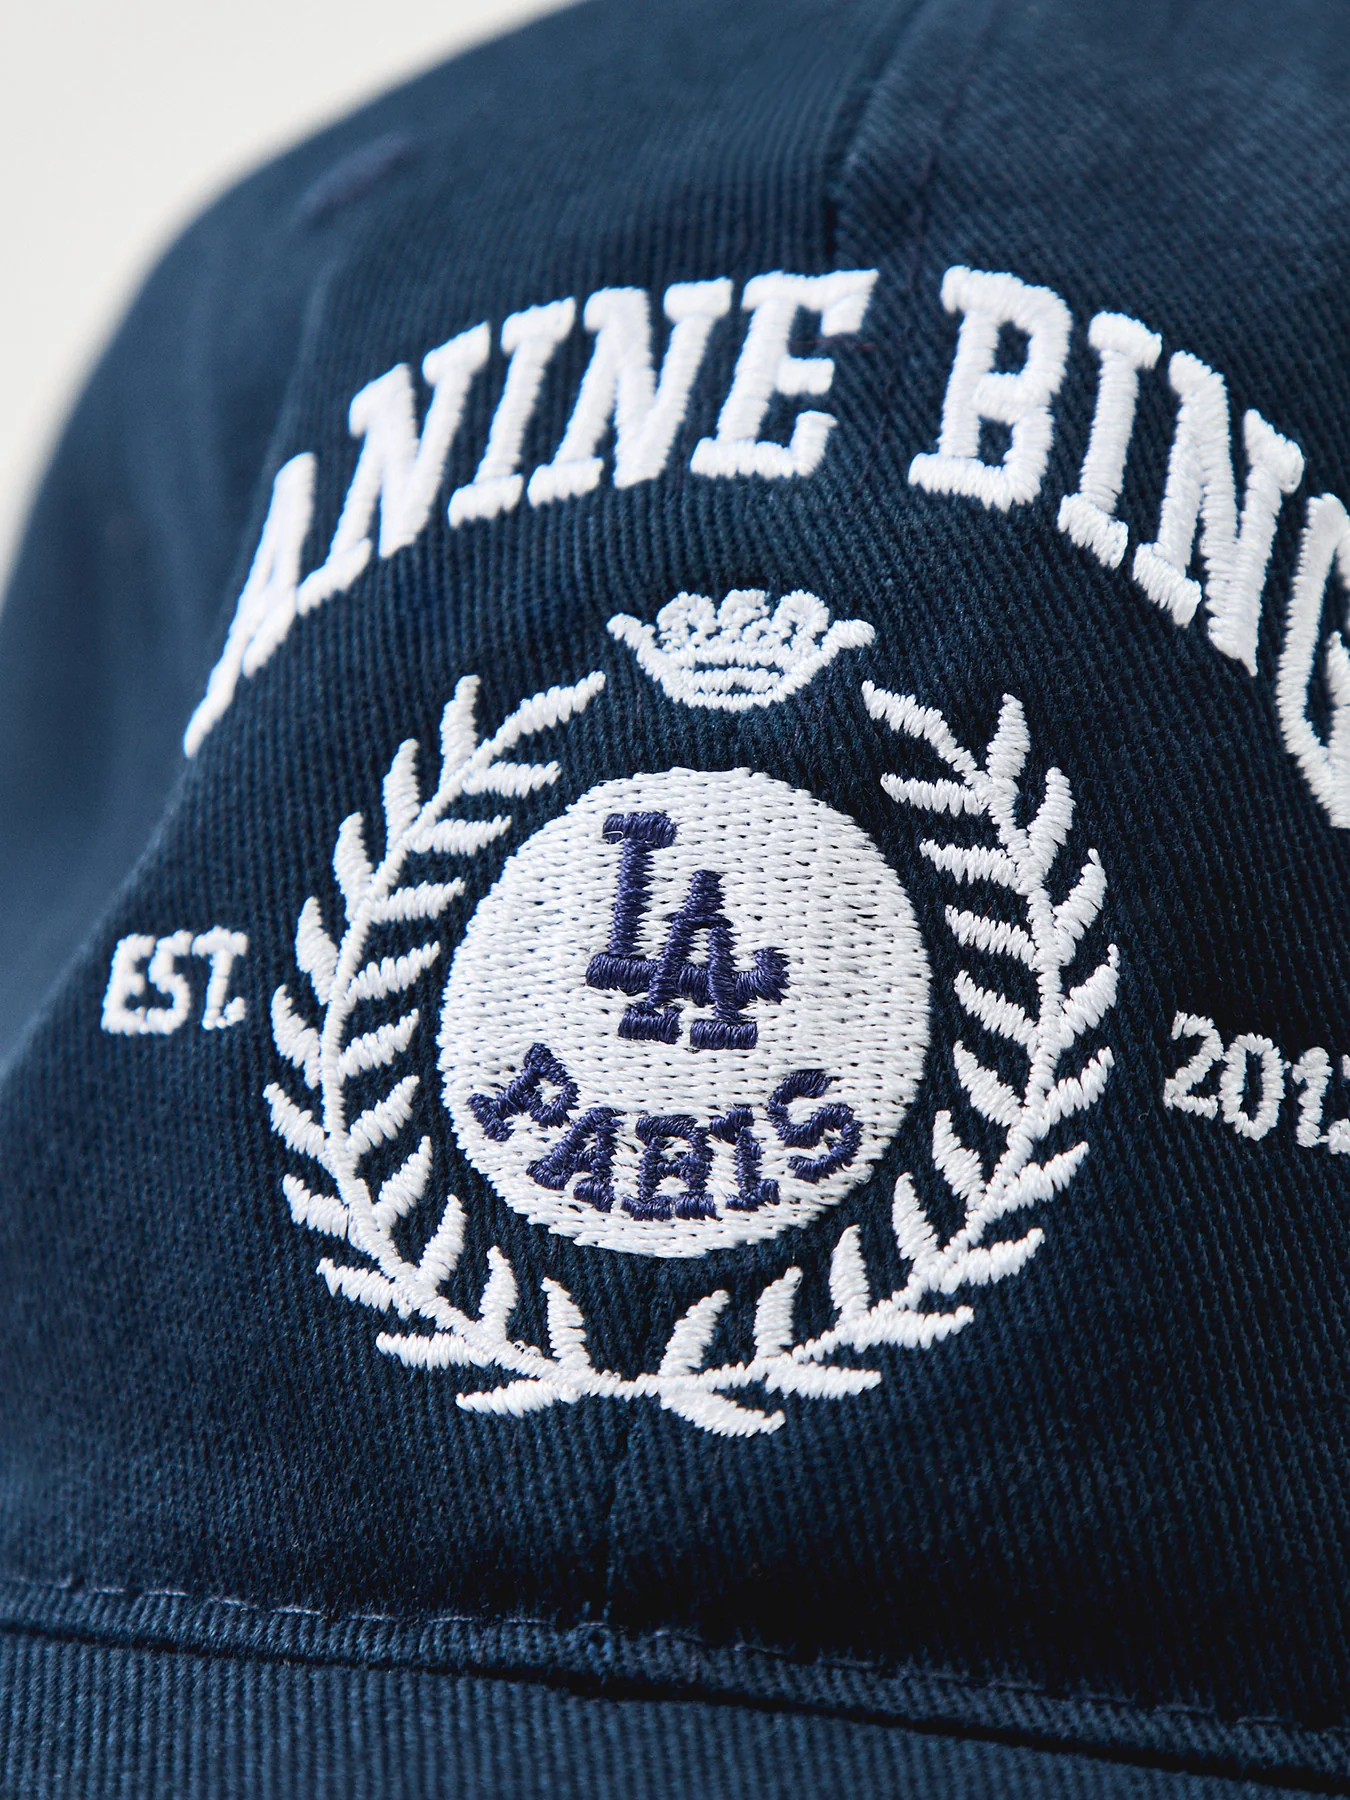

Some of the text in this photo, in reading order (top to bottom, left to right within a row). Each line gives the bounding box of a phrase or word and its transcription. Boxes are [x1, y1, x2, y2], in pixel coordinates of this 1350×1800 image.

[184, 269, 879, 757] ANINE
[101, 926, 248, 1036] EST.
[586, 811, 790, 1050] LA
[467, 1043, 863, 1221] PARIS
